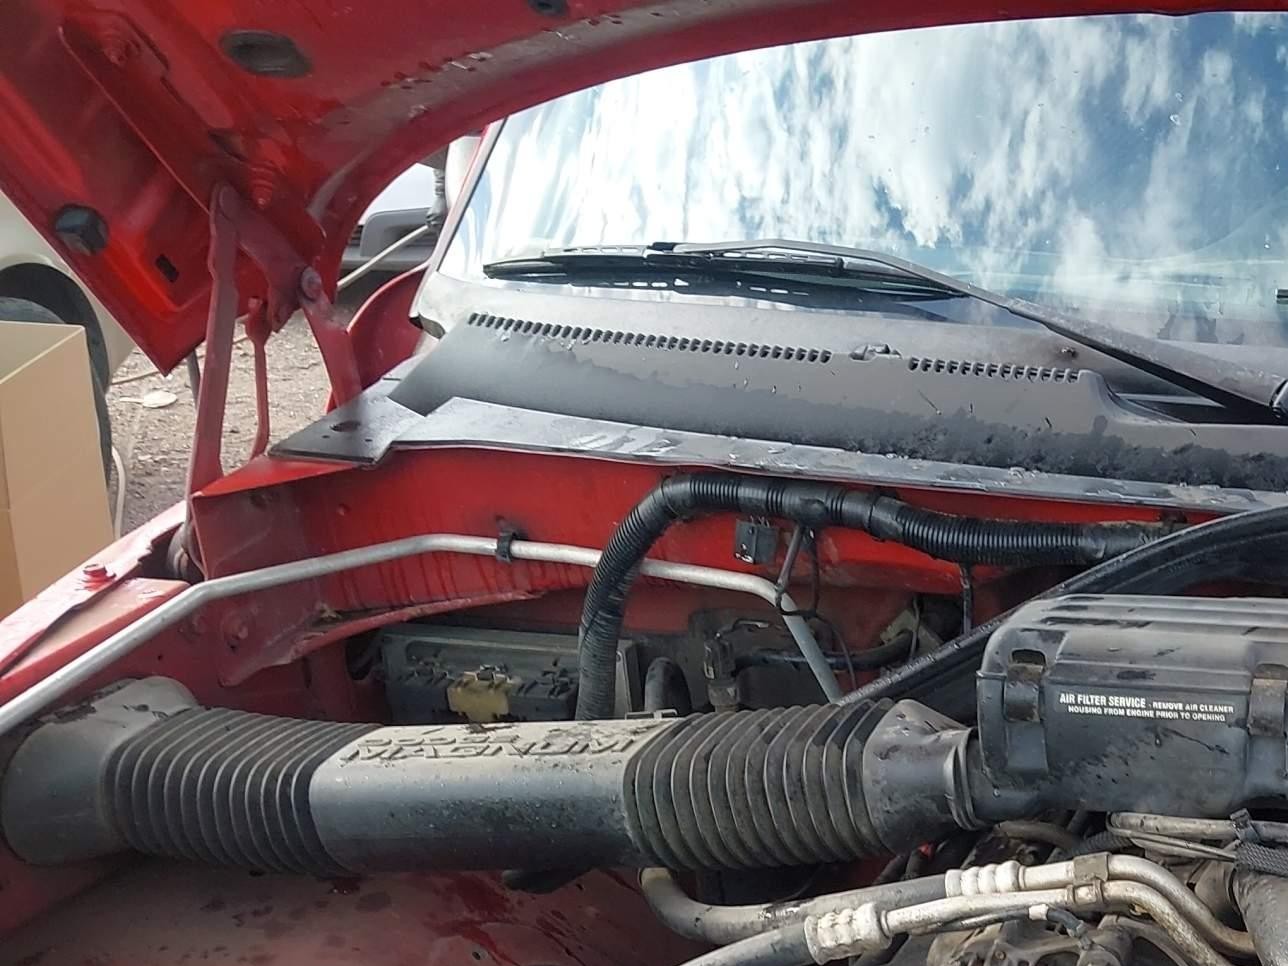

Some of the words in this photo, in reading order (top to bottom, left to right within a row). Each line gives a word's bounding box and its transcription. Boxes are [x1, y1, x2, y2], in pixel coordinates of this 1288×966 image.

[1060, 694, 1075, 704] AIR
[1077, 695, 1106, 706] FILTER
[1108, 697, 1145, 708] SERVICE
[1153, 702, 1183, 710] REMOVE
[1186, 703, 1197, 711] AIR
[1200, 704, 1234, 713] CLEANER
[1068, 705, 1102, 714] HOUSING
[1104, 708, 1124, 716] FROM
[1127, 709, 1154, 718] ENGINE
[1156, 711, 1178, 719] PRIOR
[1193, 713, 1225, 721] OPENING
[341, 737, 636, 761] MAGNUM
